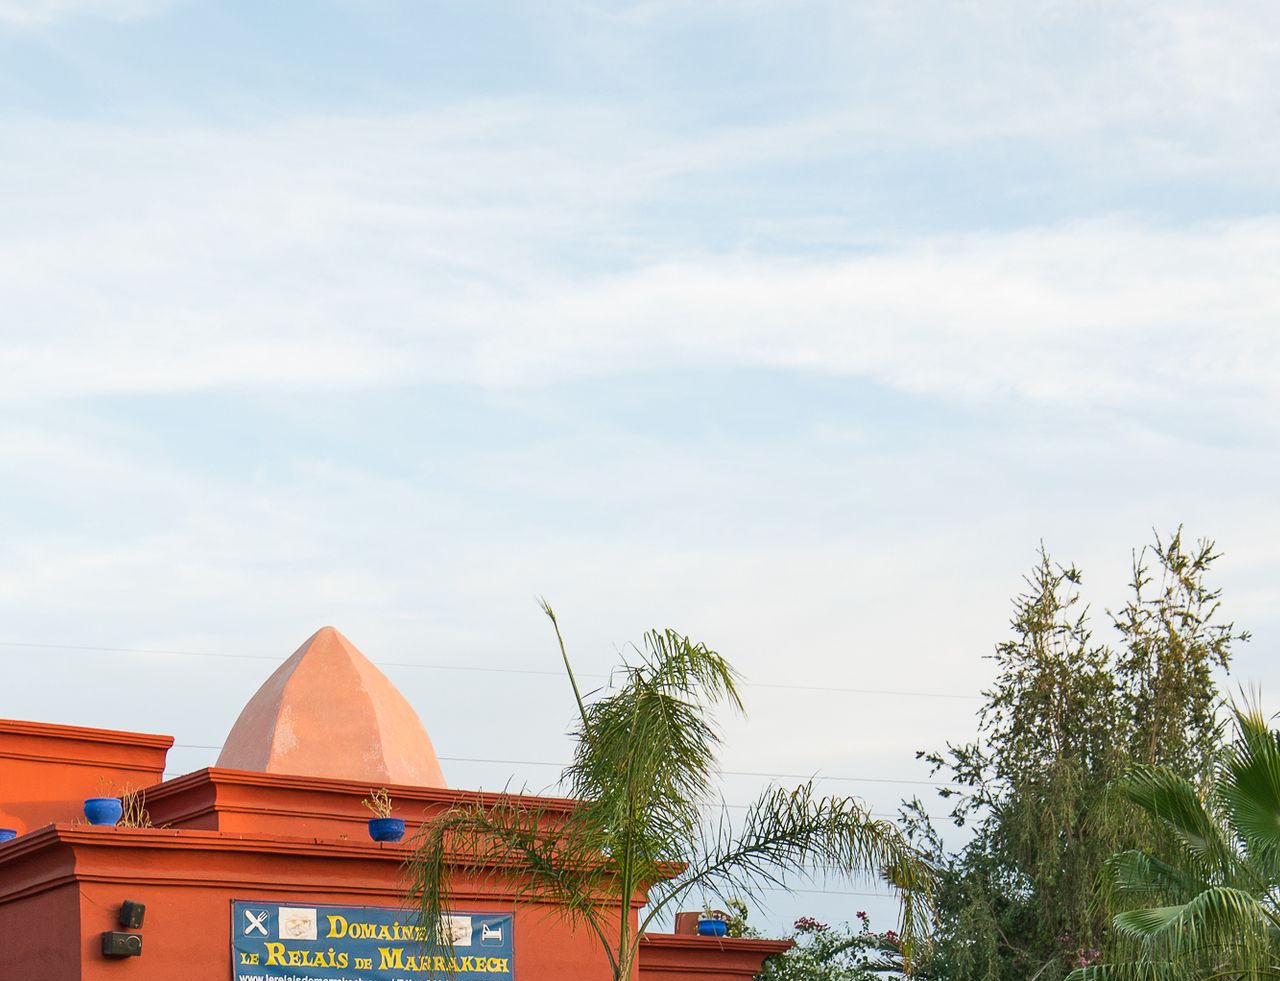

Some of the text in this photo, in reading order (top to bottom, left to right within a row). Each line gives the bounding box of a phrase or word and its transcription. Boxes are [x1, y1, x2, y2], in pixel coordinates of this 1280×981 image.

[240, 942, 509, 973] LE RELAIS DE MARRAKECH
